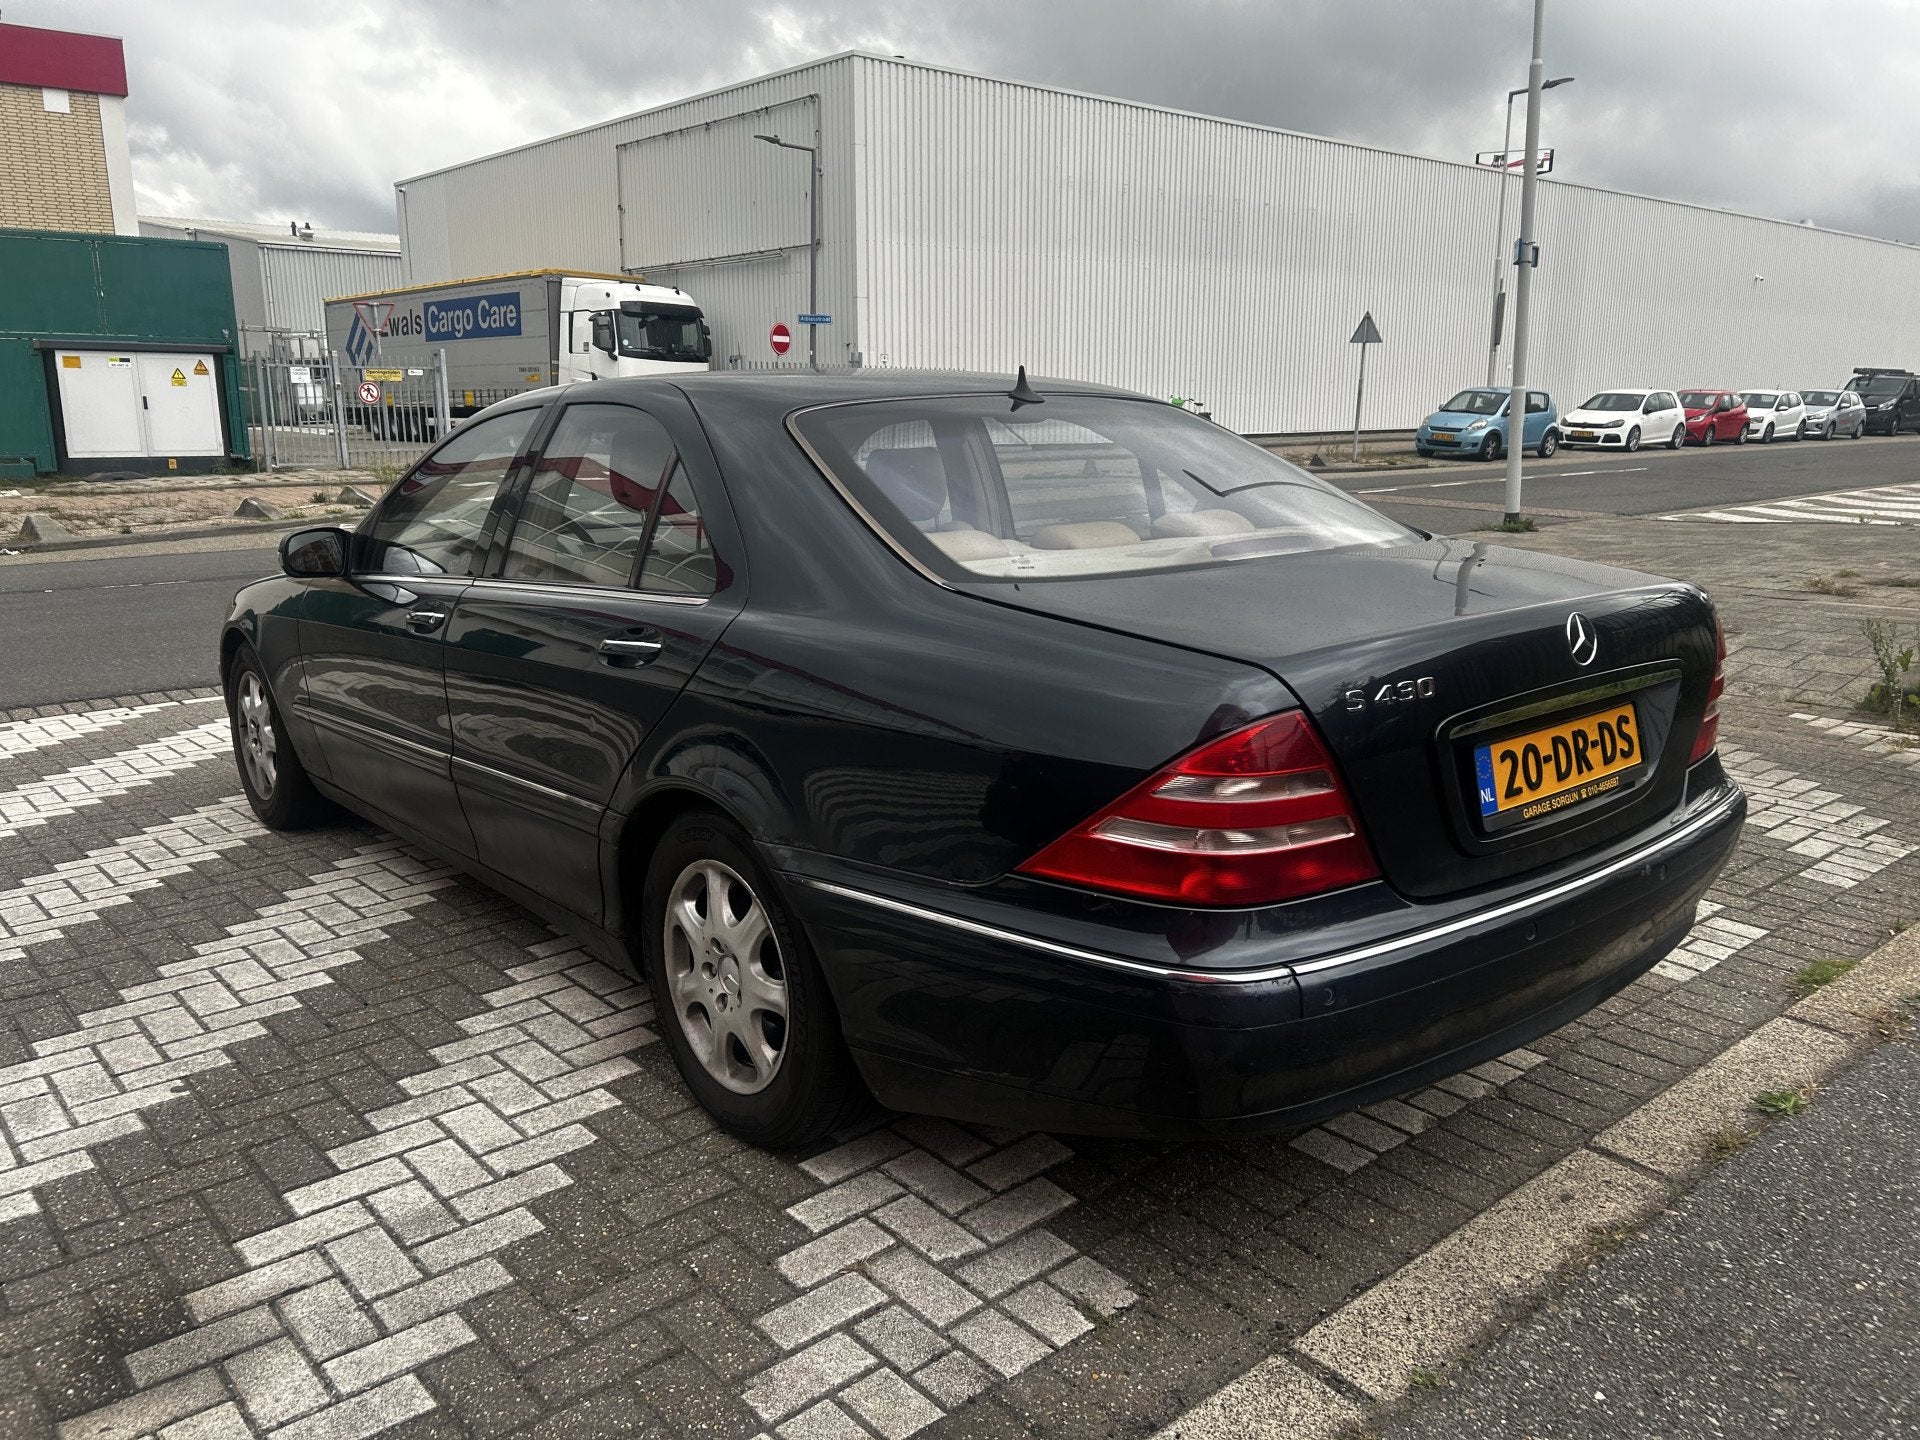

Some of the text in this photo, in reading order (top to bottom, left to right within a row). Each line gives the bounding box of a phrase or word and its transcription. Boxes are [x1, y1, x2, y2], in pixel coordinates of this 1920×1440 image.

[380, 299, 518, 338] wals Cargo Care
[1344, 676, 1436, 712] S 430
[1500, 714, 1635, 799] 20-DR-DS
[1480, 787, 1495, 804] NL
[1523, 801, 1552, 819] GARAGE
[1551, 791, 1579, 809] SORGUN
